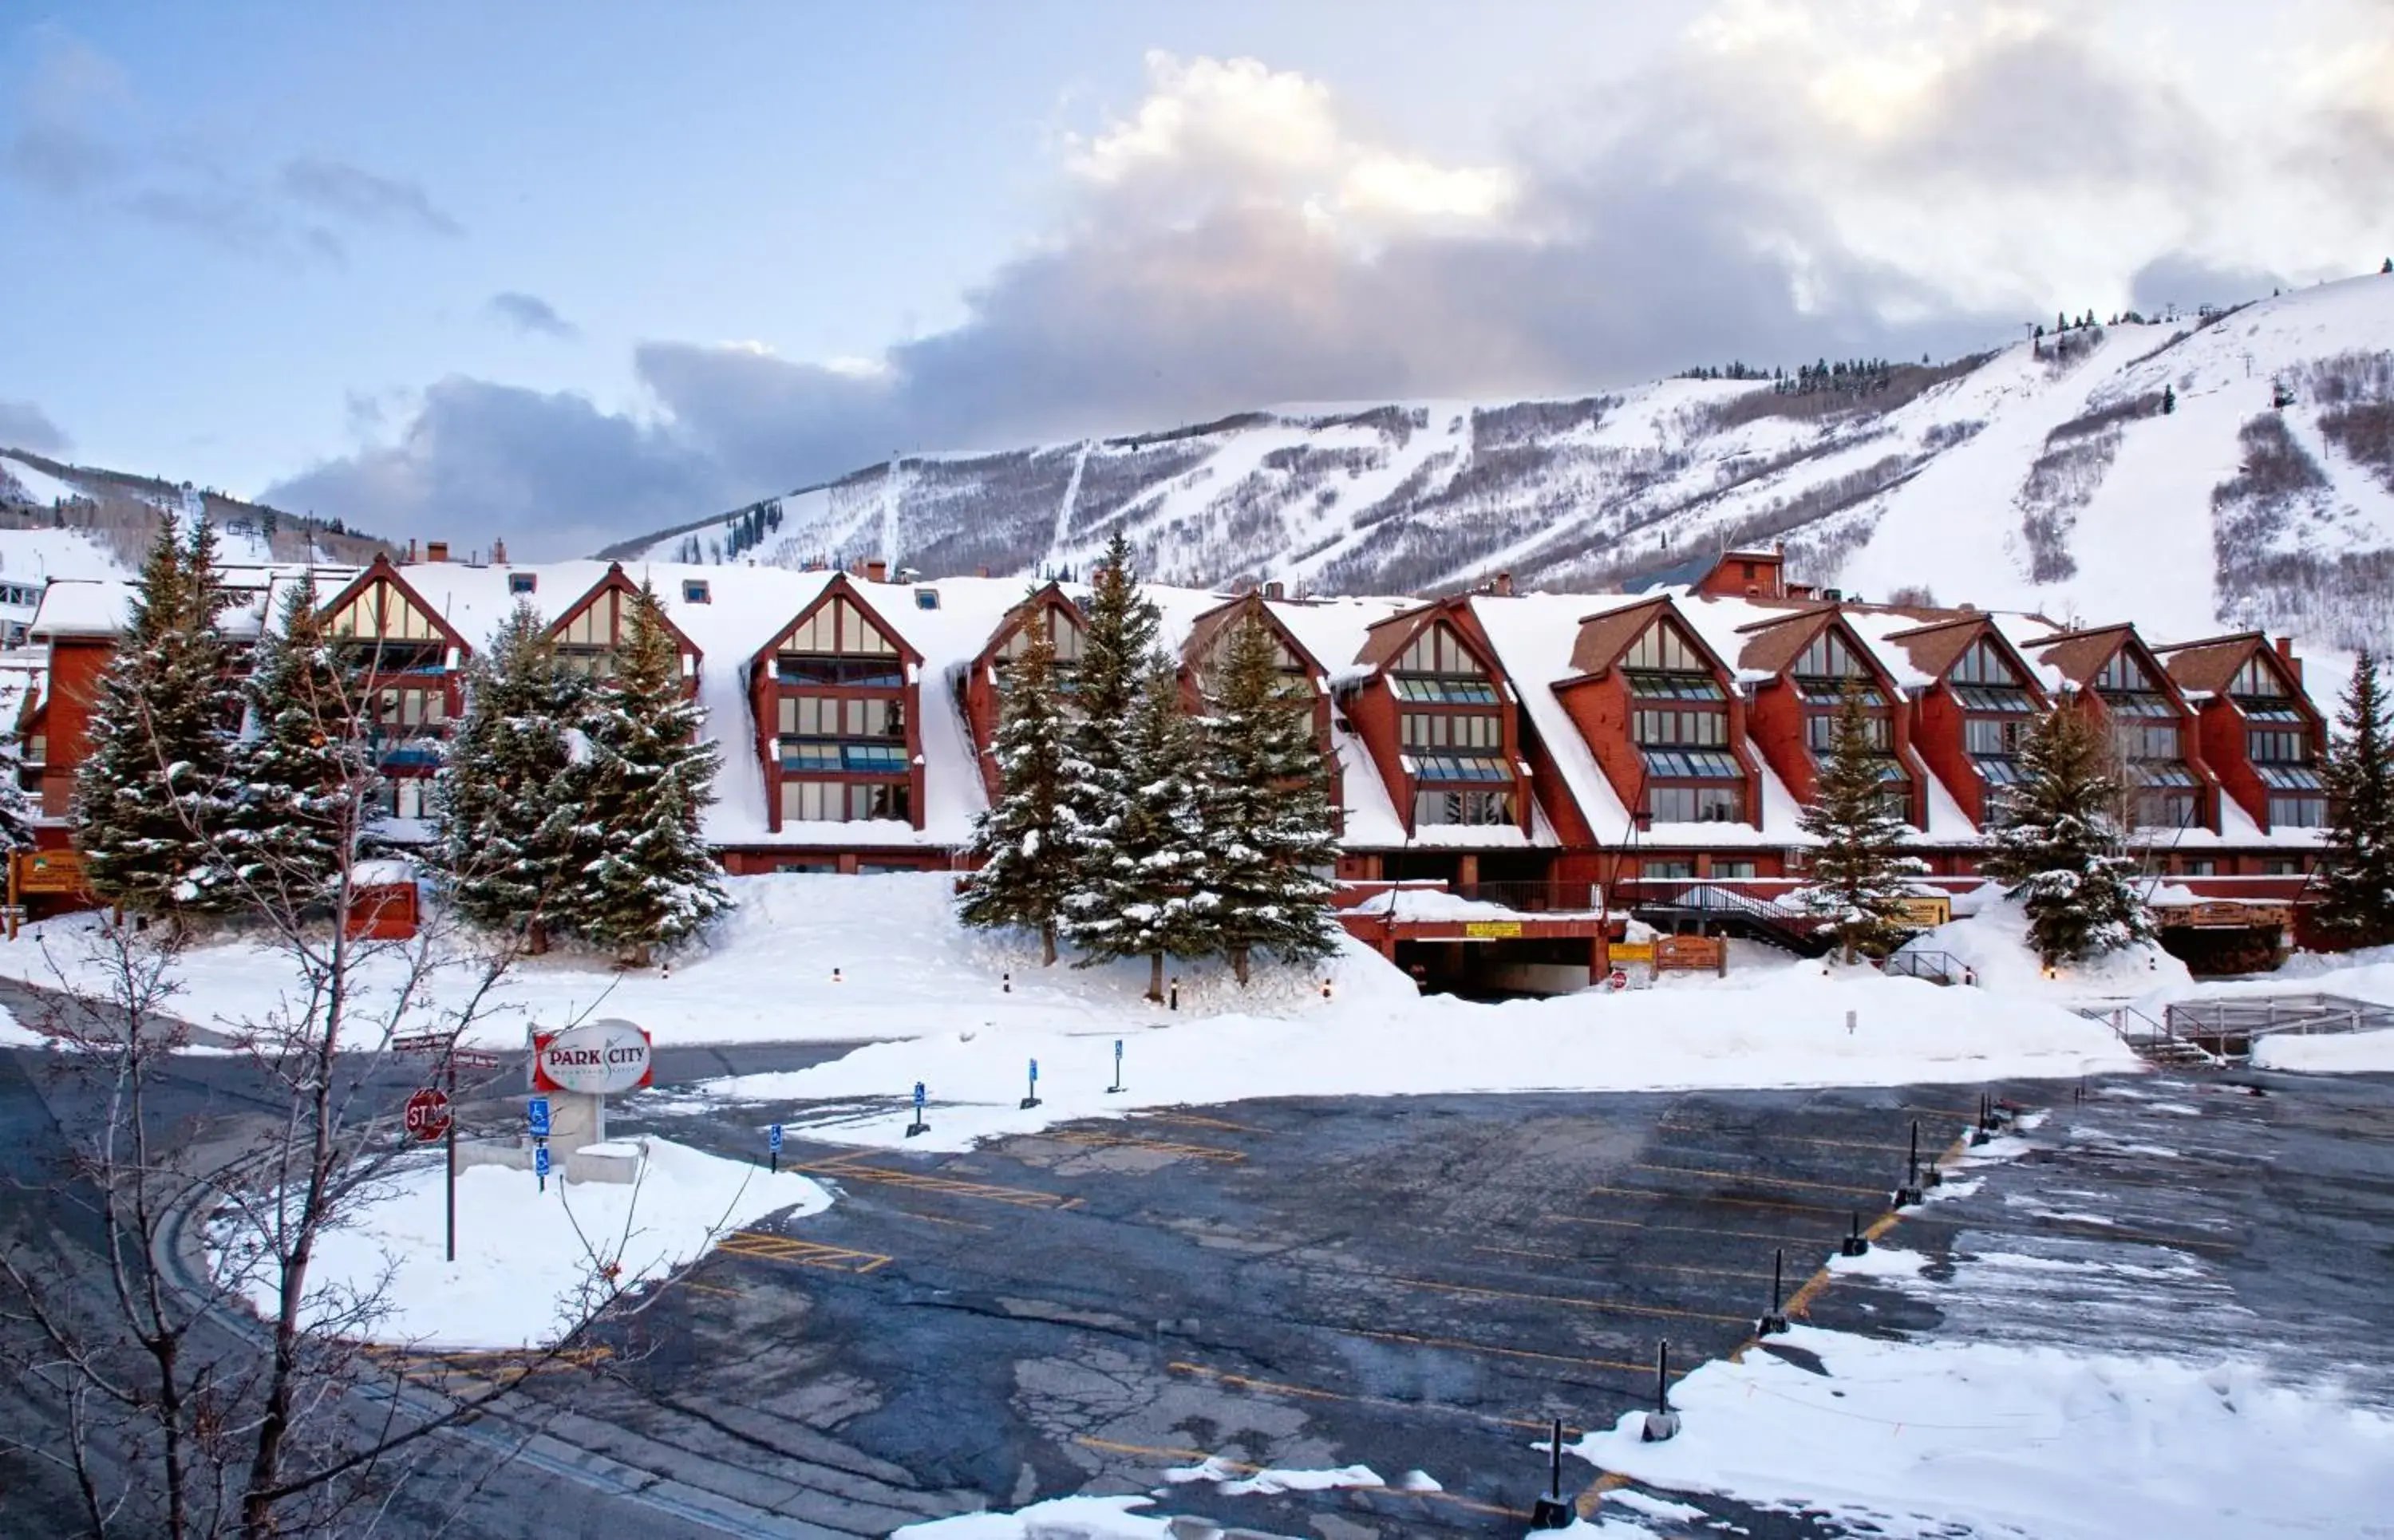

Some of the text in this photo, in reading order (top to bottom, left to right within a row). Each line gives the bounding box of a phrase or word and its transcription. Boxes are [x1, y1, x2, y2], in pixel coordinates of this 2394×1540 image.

[550, 1046, 645, 1065] PARK CITY
[409, 1103, 446, 1126] ST
